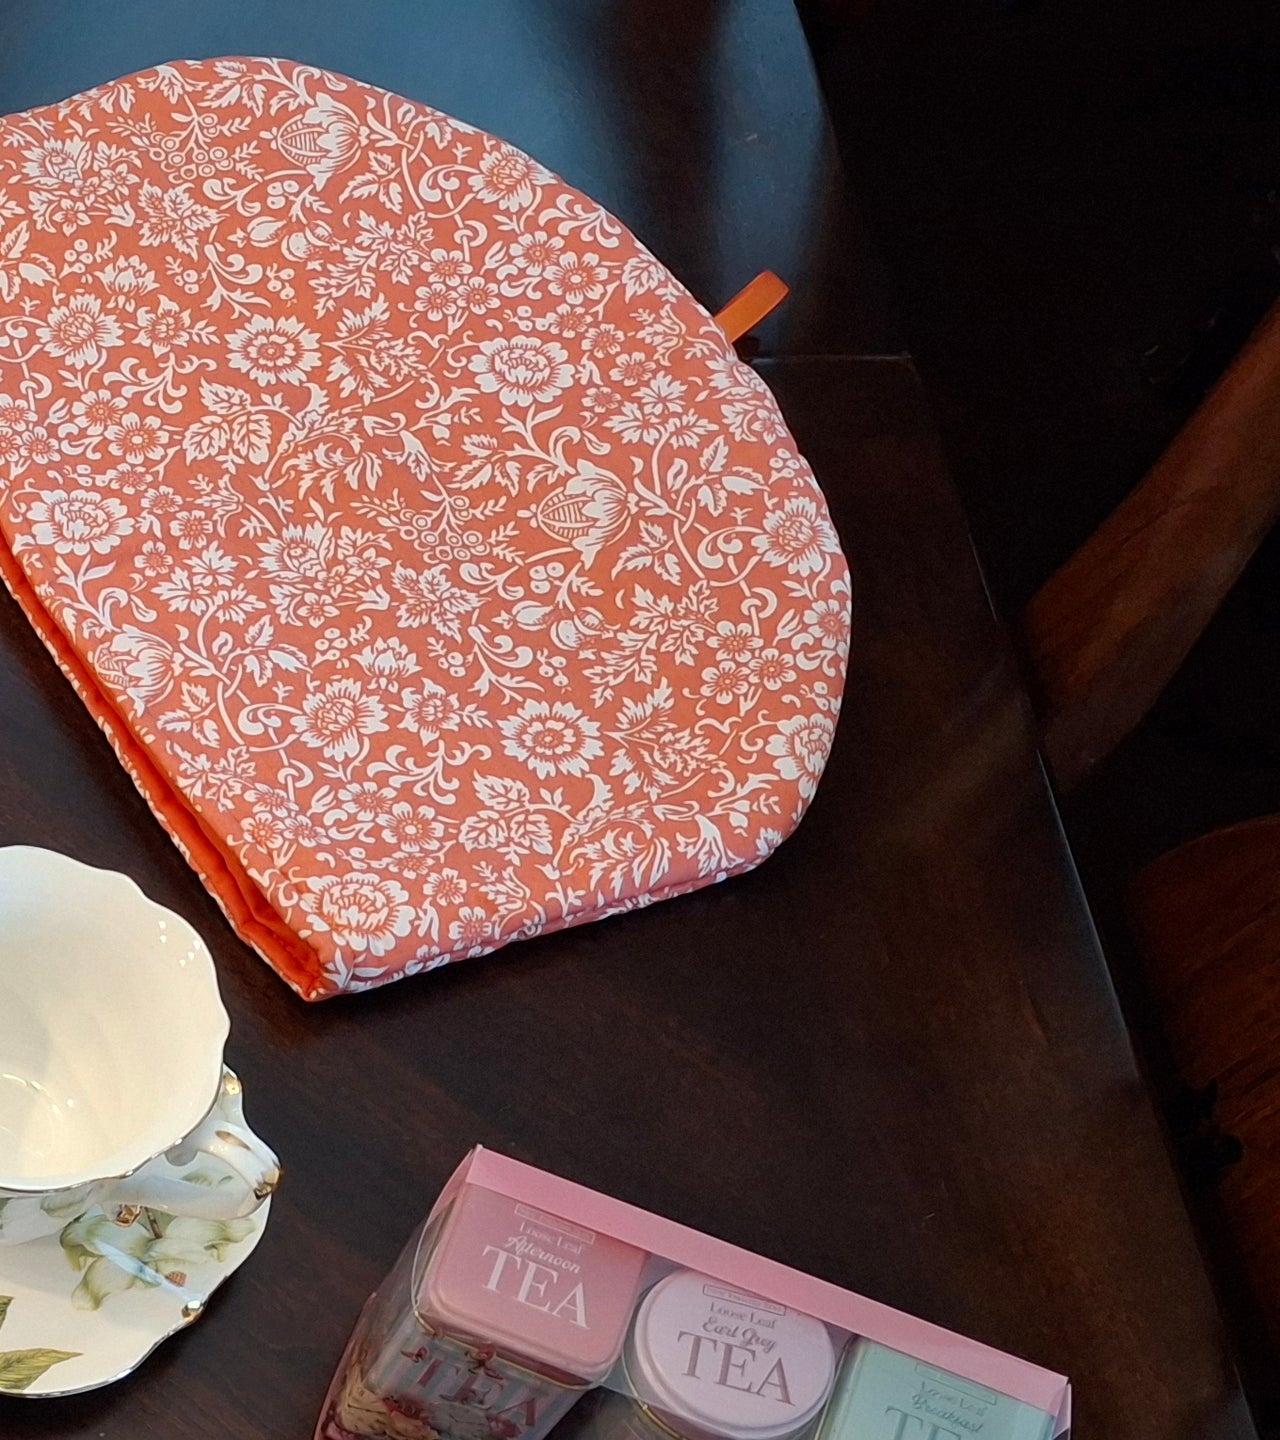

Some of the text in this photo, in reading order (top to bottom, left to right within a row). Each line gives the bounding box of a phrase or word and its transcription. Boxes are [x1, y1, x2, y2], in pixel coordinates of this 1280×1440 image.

[482, 1245, 591, 1330] TEA
[504, 1235, 581, 1275] Afternoon
[677, 1331, 796, 1407] TEA
[702, 1316, 777, 1354] Earl Grey
[417, 1357, 541, 1427] TEA
